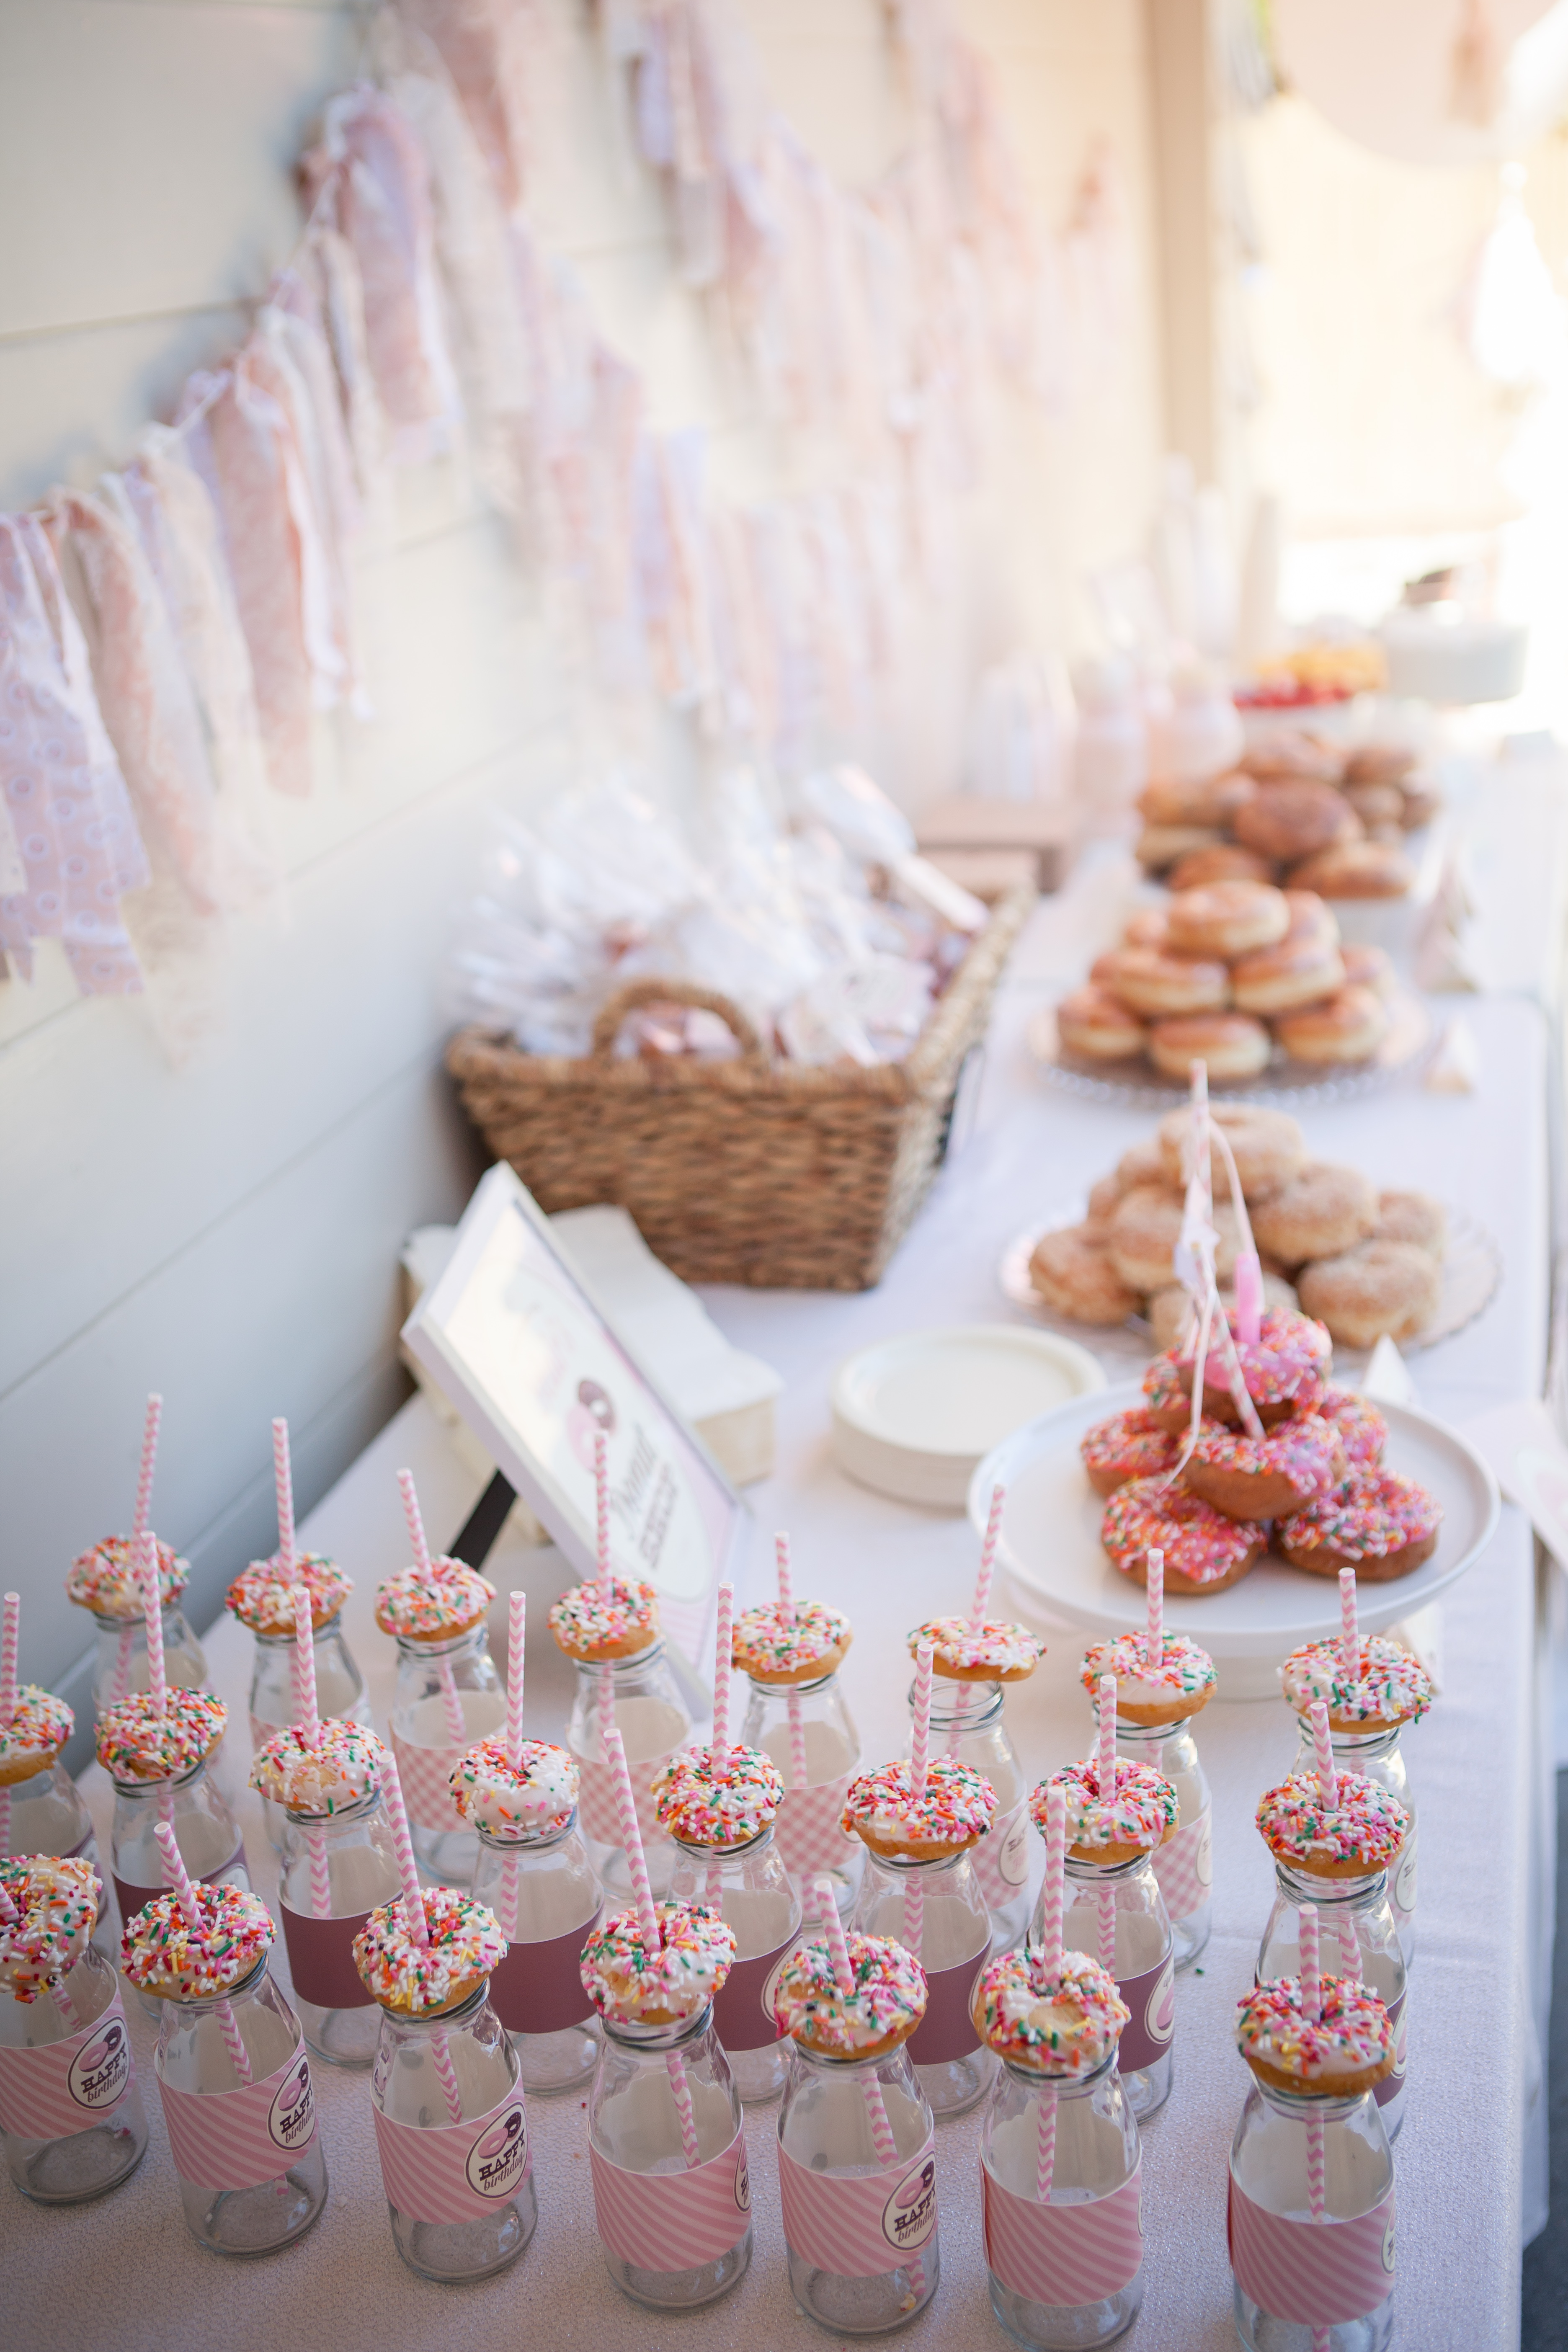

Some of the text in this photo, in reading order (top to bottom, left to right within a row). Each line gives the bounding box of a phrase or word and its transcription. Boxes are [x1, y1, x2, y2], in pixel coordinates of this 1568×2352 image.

[80, 2041, 126, 2094] HAPPY
[280, 2080, 313, 2134] HAPPY
[478, 2128, 525, 2181] HAPPY
[895, 2179, 936, 2233] HAPPY
